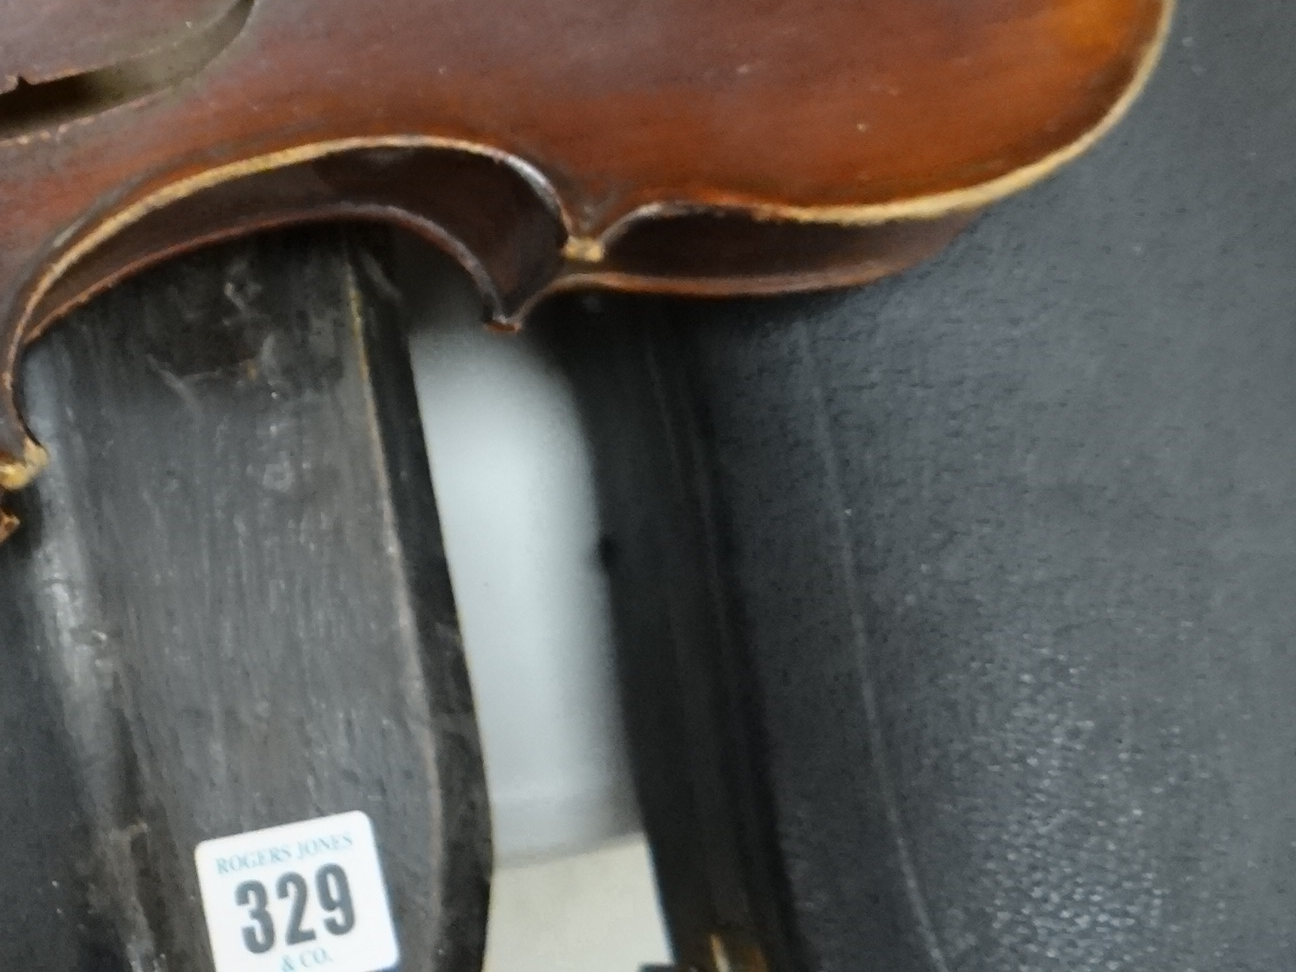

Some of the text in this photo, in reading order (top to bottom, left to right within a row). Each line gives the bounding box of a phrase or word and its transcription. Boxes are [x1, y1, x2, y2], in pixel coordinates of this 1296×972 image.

[216, 832, 353, 874] ROGERS JONES
[234, 862, 356, 954] 329
[280, 955, 295, 972] &
